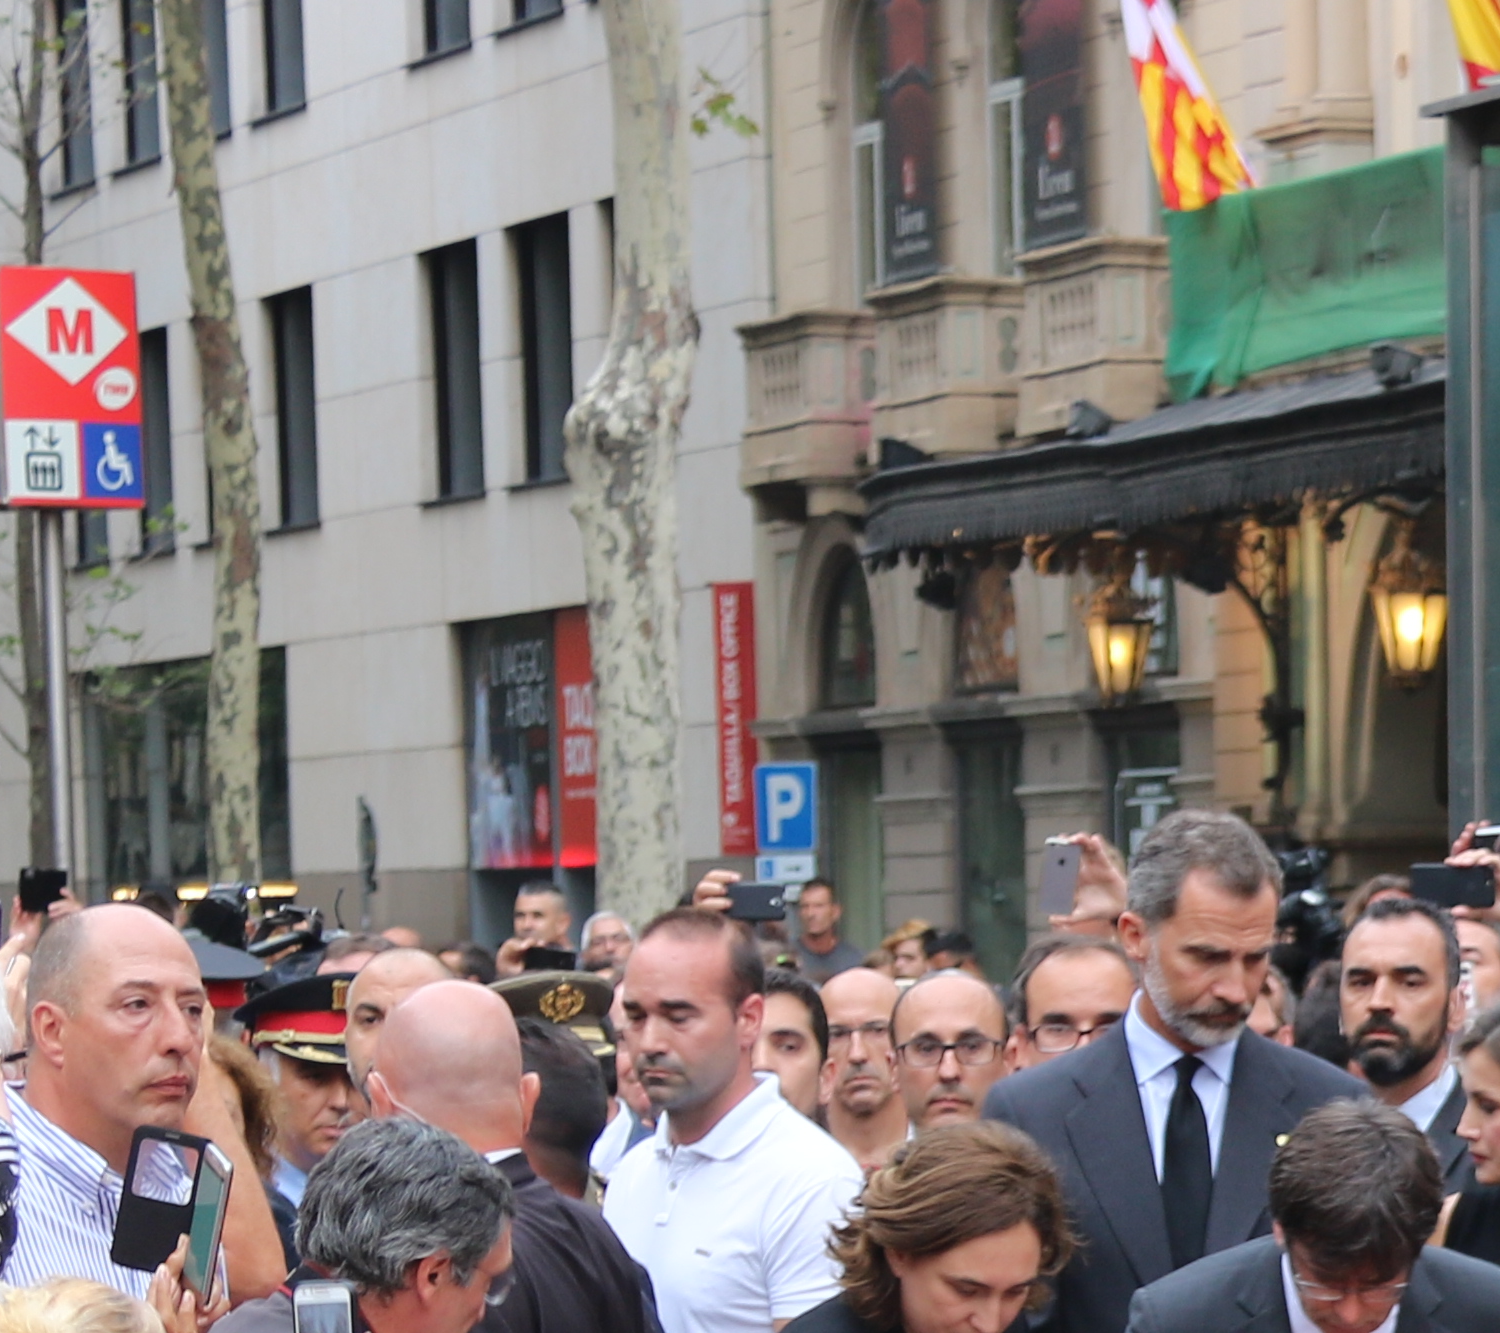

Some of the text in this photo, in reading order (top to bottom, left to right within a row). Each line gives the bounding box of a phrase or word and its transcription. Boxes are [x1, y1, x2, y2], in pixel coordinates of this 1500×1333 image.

[47, 308, 92, 353] M
[562, 683, 594, 729] TAQ
[765, 773, 805, 843] P
